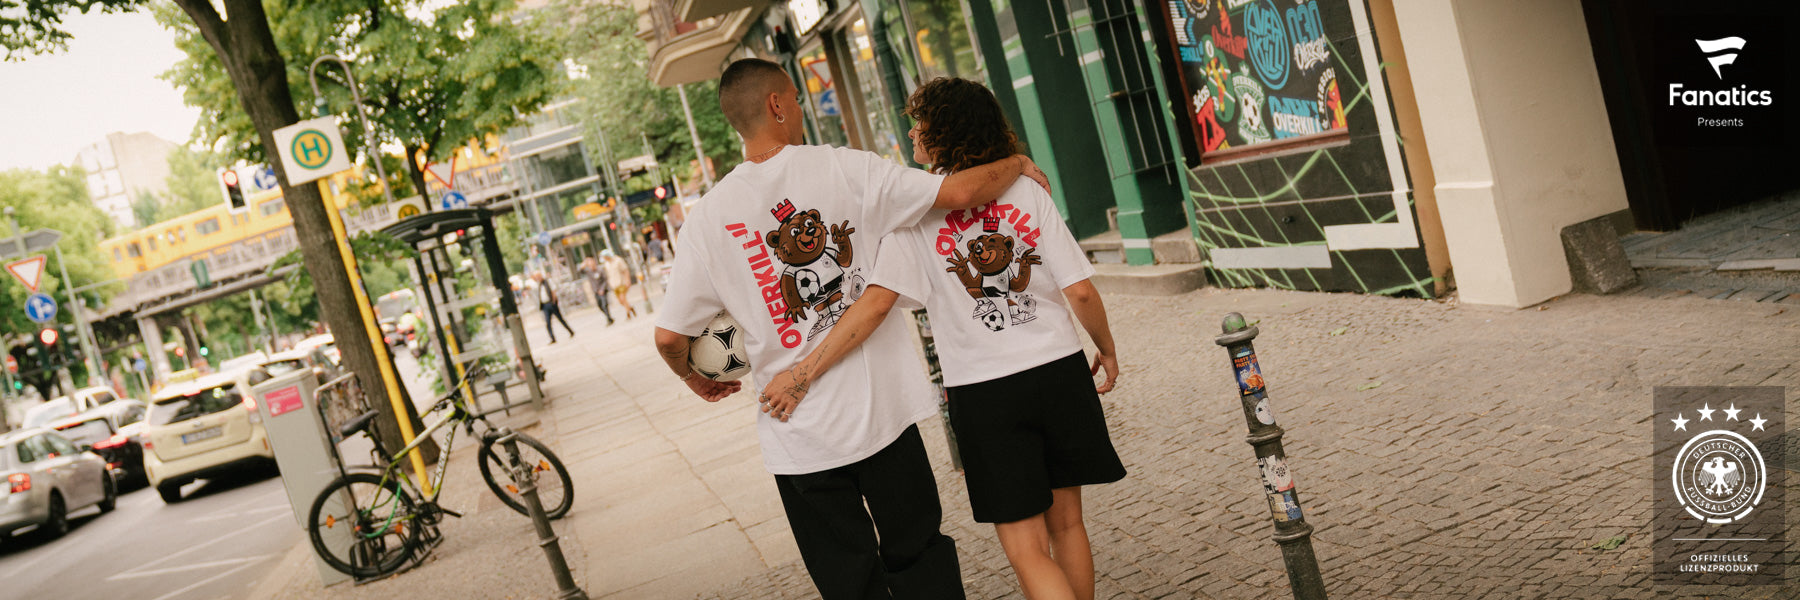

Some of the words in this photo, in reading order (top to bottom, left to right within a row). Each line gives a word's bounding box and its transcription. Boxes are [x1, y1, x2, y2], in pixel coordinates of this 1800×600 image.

[1286, 0, 1325, 48] 030
[300, 137, 323, 161] H
[935, 200, 1041, 257] OVERKILL
[742, 230, 802, 349] OVERKILL
